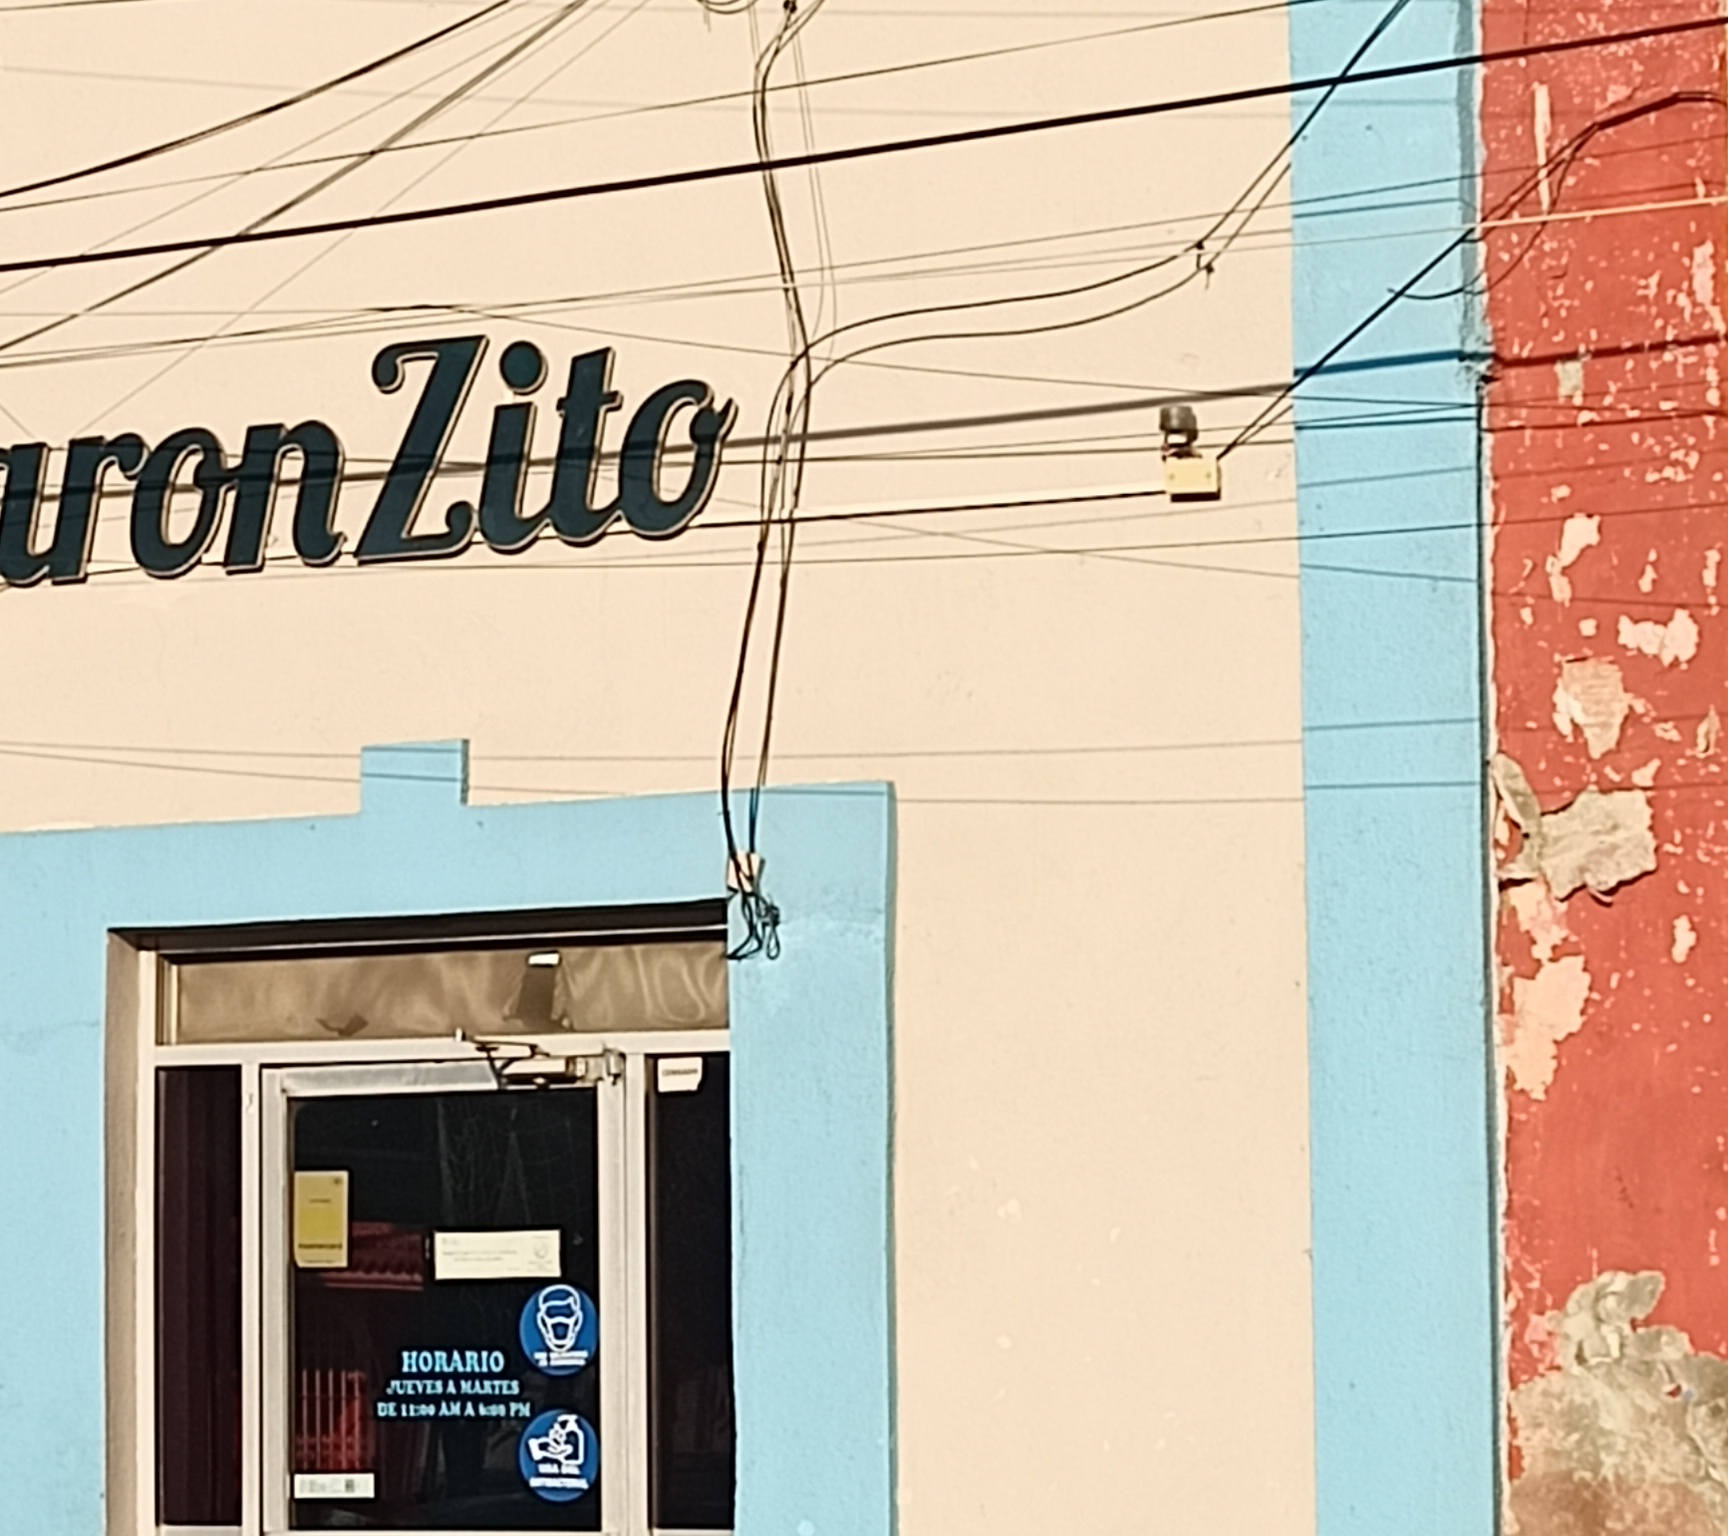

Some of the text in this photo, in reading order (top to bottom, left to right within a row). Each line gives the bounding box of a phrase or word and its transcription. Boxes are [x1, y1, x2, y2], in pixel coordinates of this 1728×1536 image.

[401, 1349, 505, 1373] HORARIO
[386, 1380, 520, 1395] JUEVES A MARTES
[377, 1401, 397, 1417] DE
[438, 1400, 461, 1417] AM
[464, 1401, 476, 1417] A
[509, 1401, 531, 1418] PM
